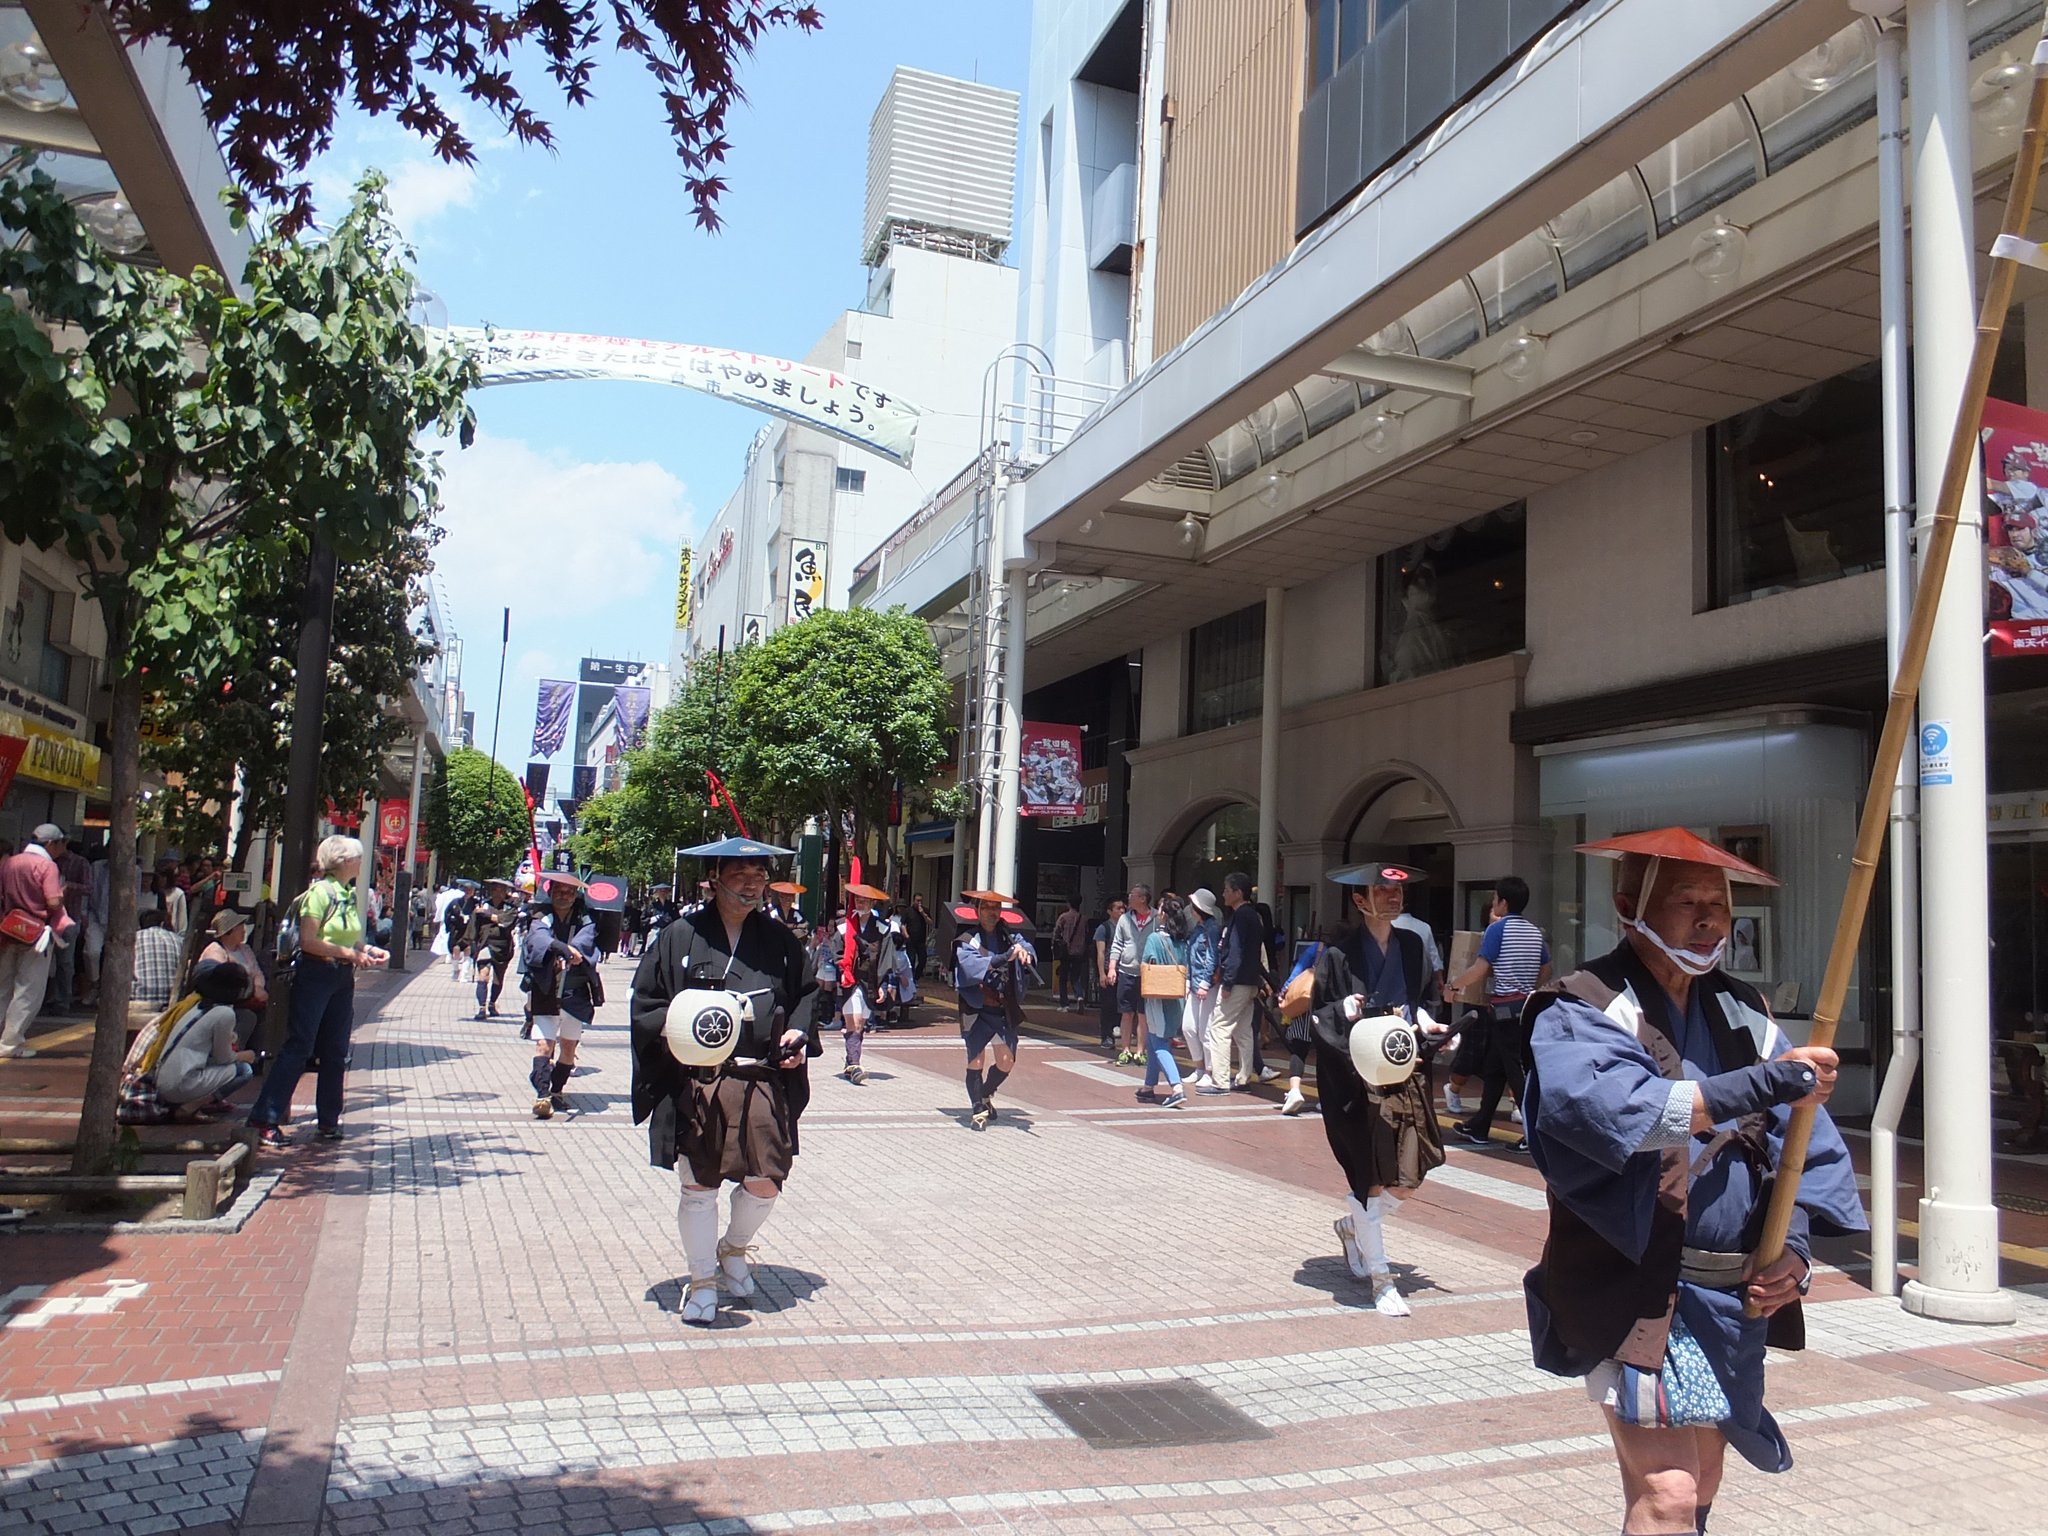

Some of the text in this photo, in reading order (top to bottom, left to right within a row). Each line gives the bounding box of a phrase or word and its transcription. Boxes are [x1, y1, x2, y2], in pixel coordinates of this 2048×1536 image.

[815, 543, 827, 551] B1
[589, 661, 639, 674] 第一生命
[31, 737, 86, 778] PENGUIN
